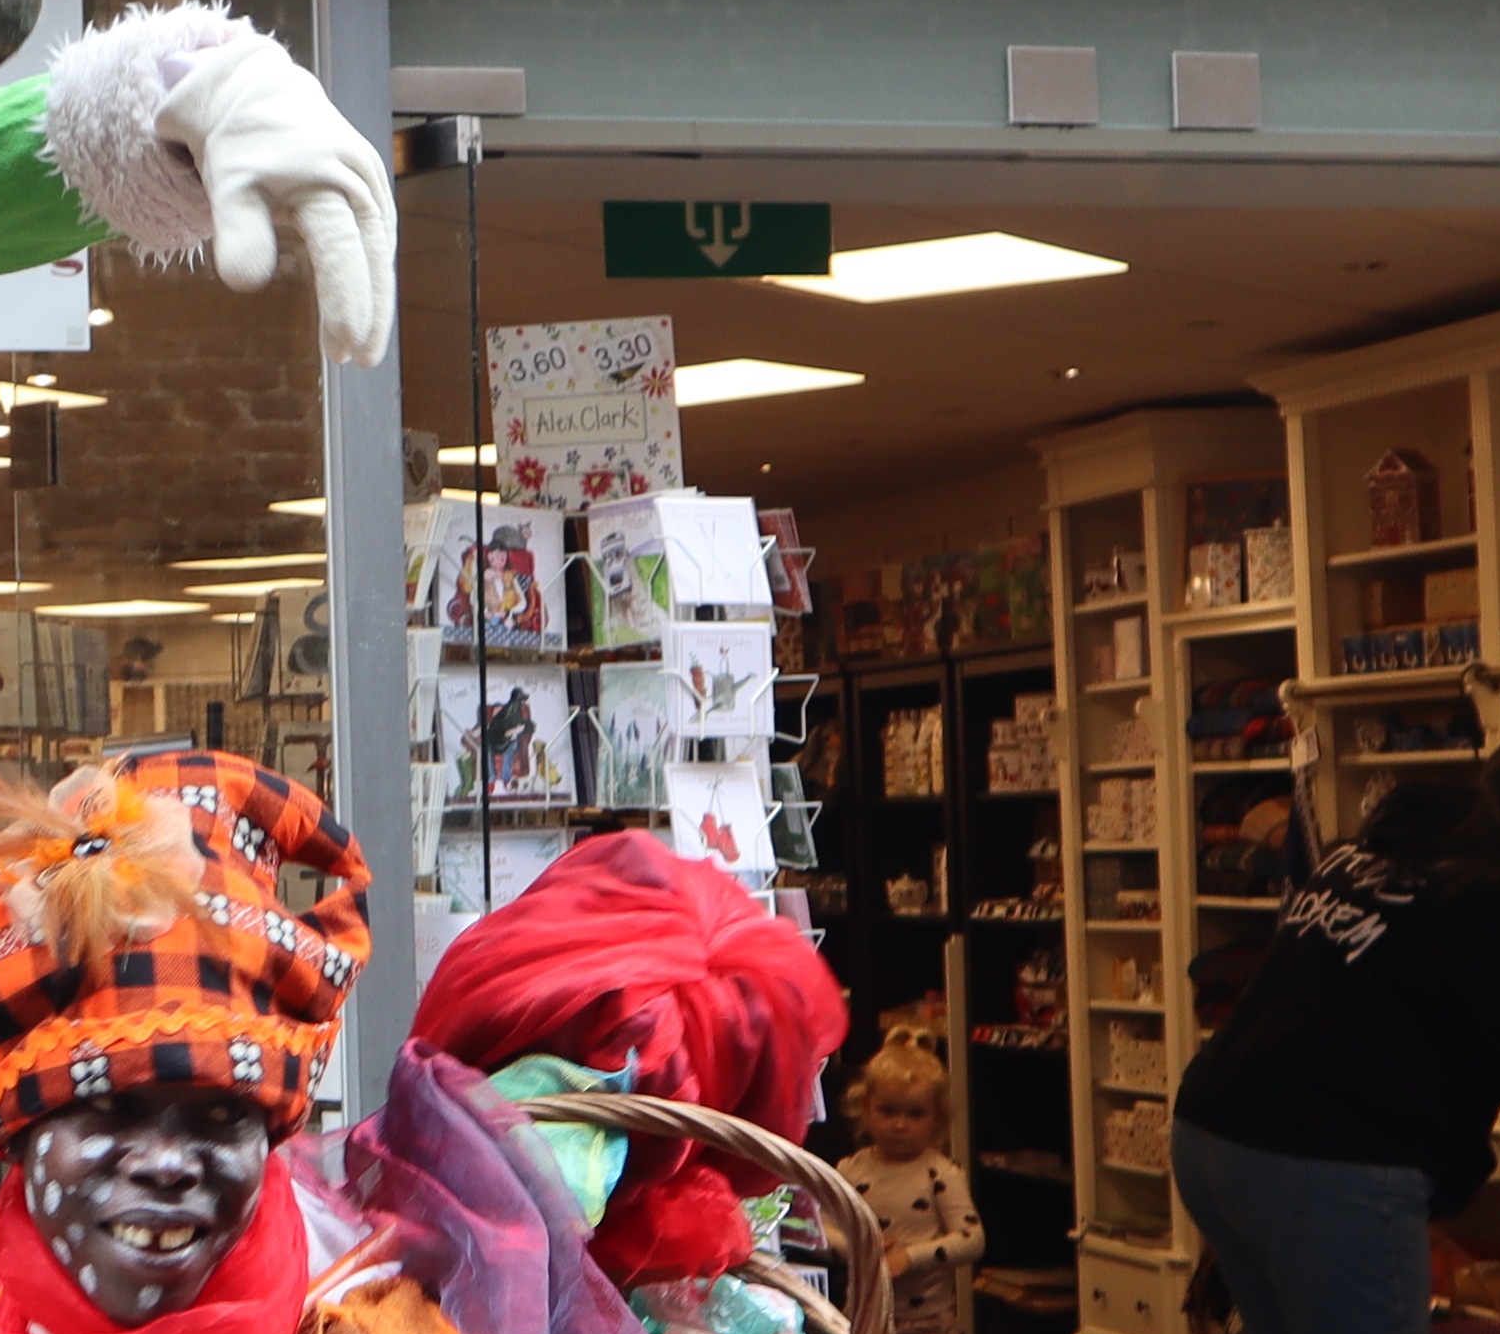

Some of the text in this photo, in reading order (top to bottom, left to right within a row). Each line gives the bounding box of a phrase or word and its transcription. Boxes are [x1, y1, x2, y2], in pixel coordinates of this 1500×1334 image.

[509, 346, 567, 383] 3,60
[594, 333, 653, 370] 3,30
[536, 401, 639, 436] Alex Clark
